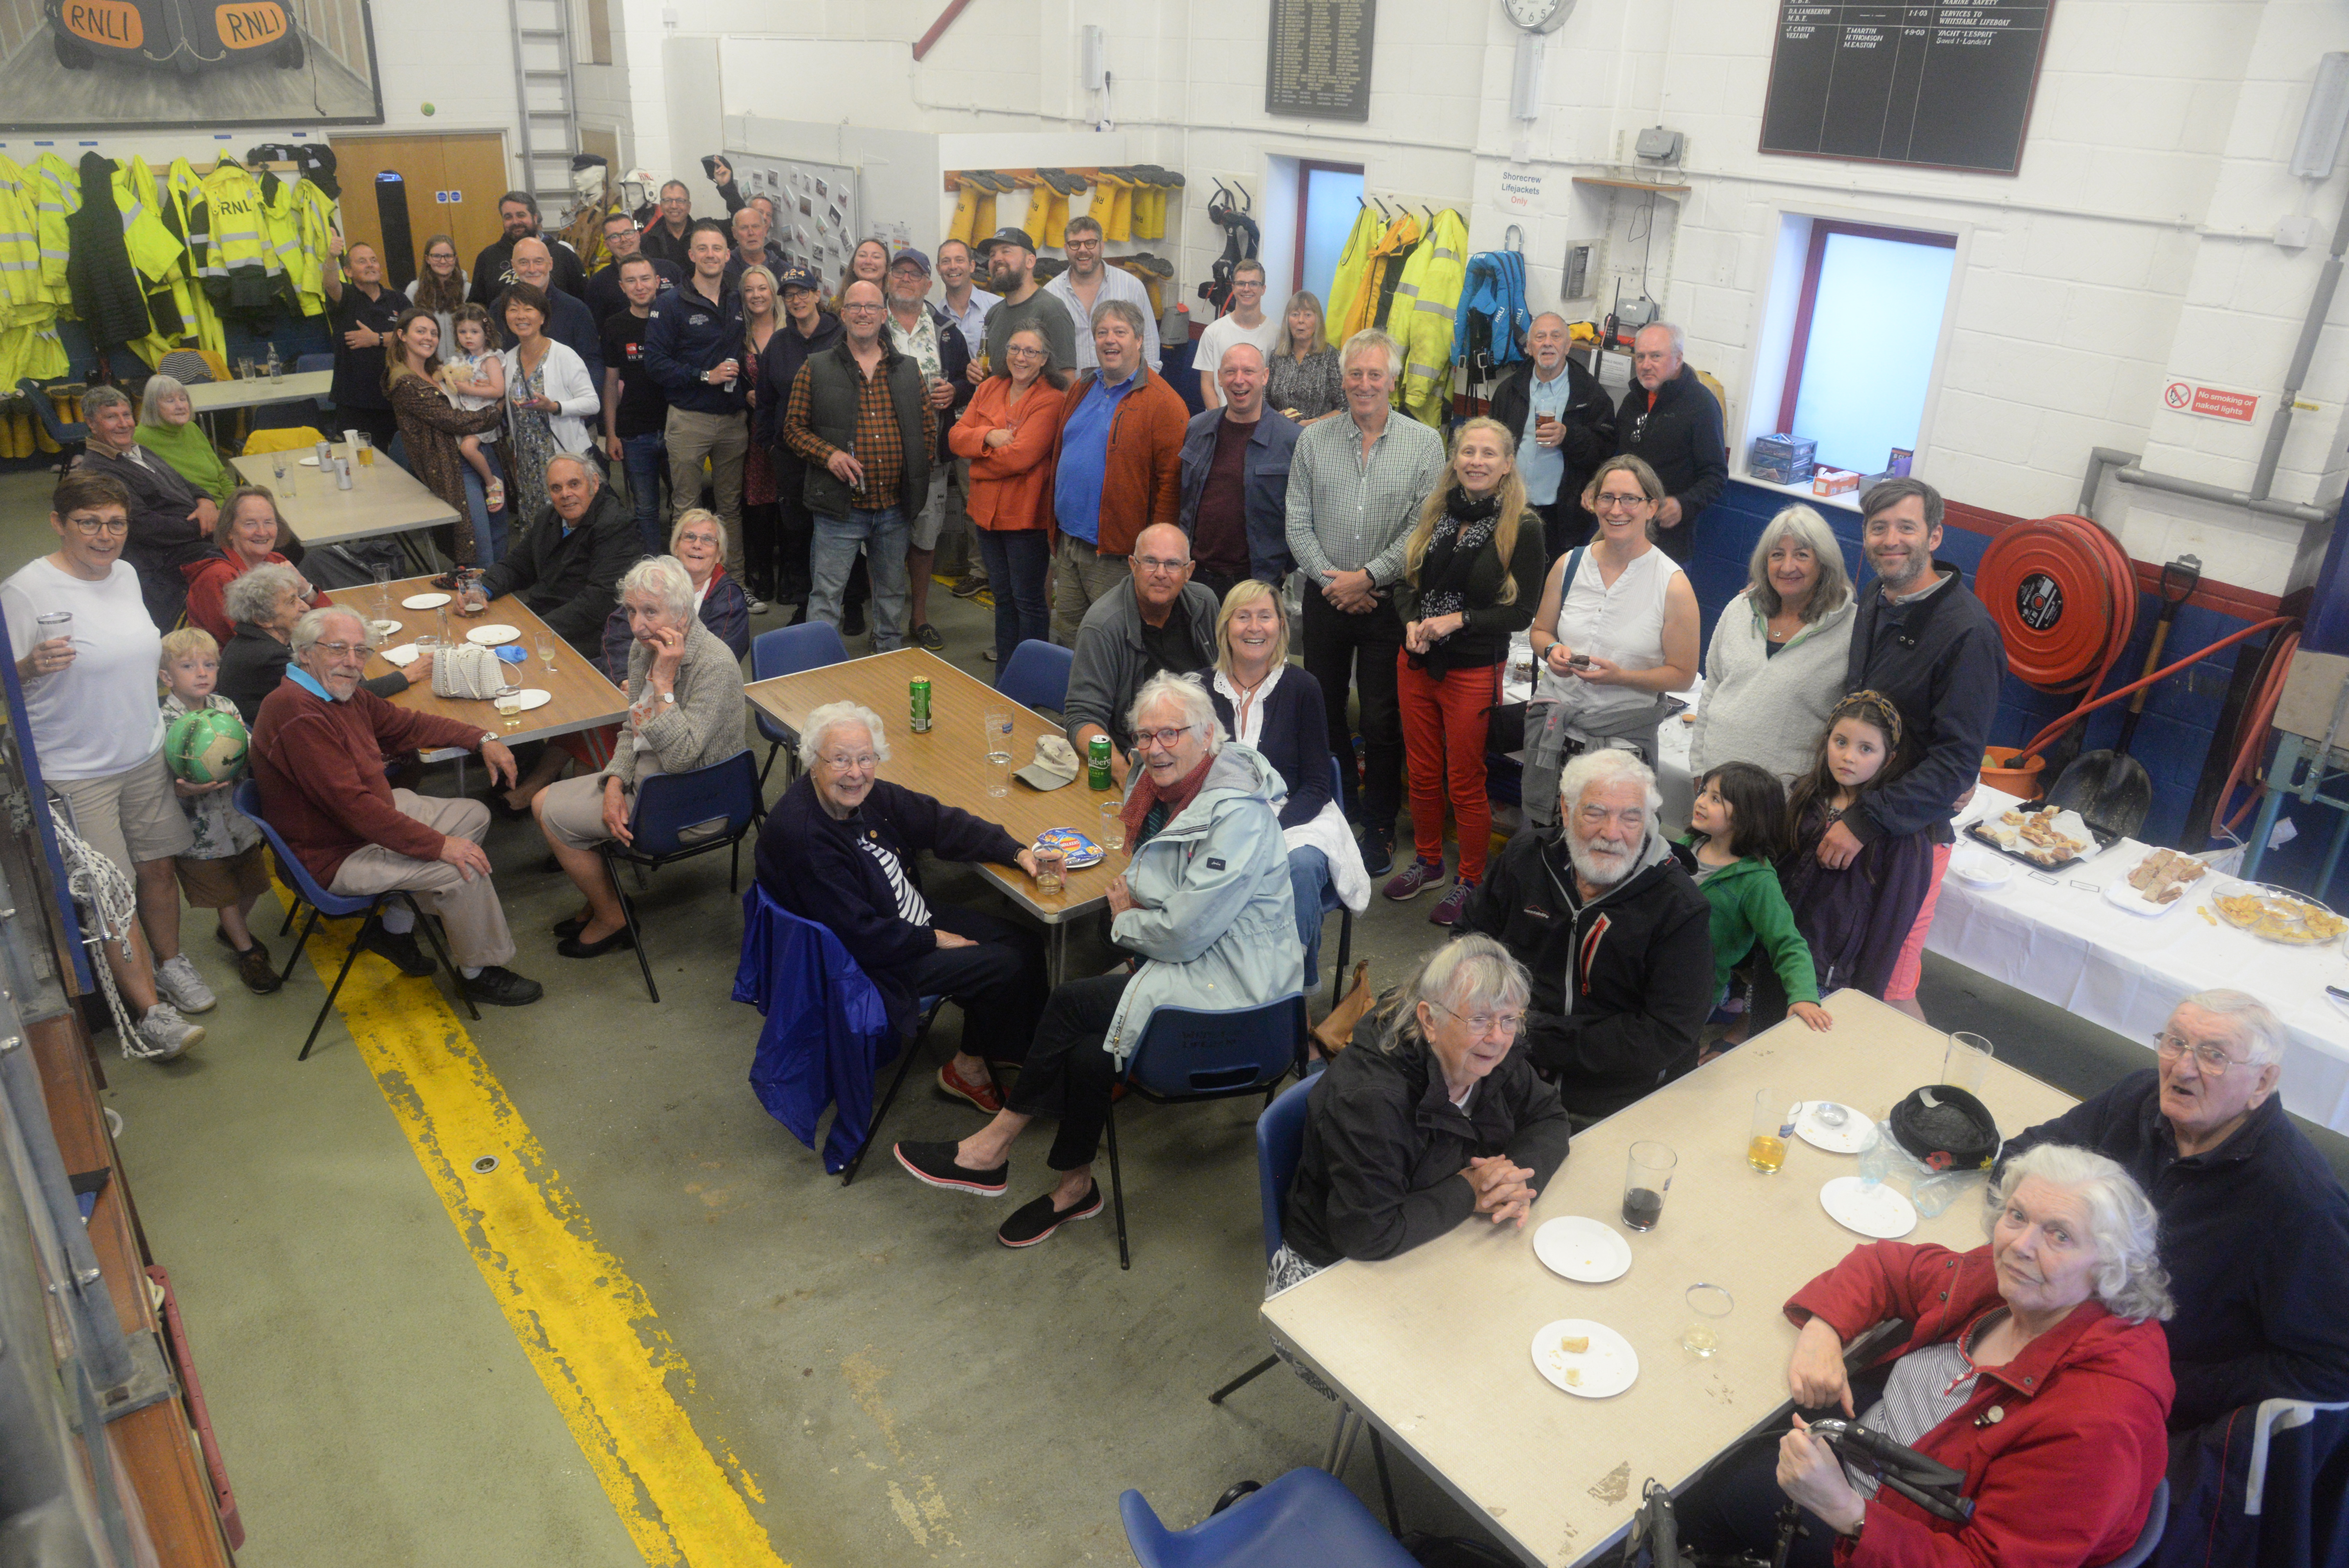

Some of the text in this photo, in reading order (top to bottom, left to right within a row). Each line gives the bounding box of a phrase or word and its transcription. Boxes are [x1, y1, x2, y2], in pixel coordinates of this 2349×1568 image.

[1518, 7, 1524, 16] 7
[1529, 12, 1534, 21] 6
[1540, 9, 1546, 19] 5
[72, 5, 128, 42] RNLI
[226, 9, 280, 43] RNLI
[1503, 172, 1542, 184] Shorecrew
[1502, 184, 1540, 195] Lifejackets
[1511, 196, 1527, 207] Only
[781, 269, 806, 282] 1824
[1495, 306, 1505, 323] RNLI
[1515, 308, 1524, 324] RNLI
[2210, 394, 2243, 406] smoking
[2196, 401, 2243, 415] naked lights
